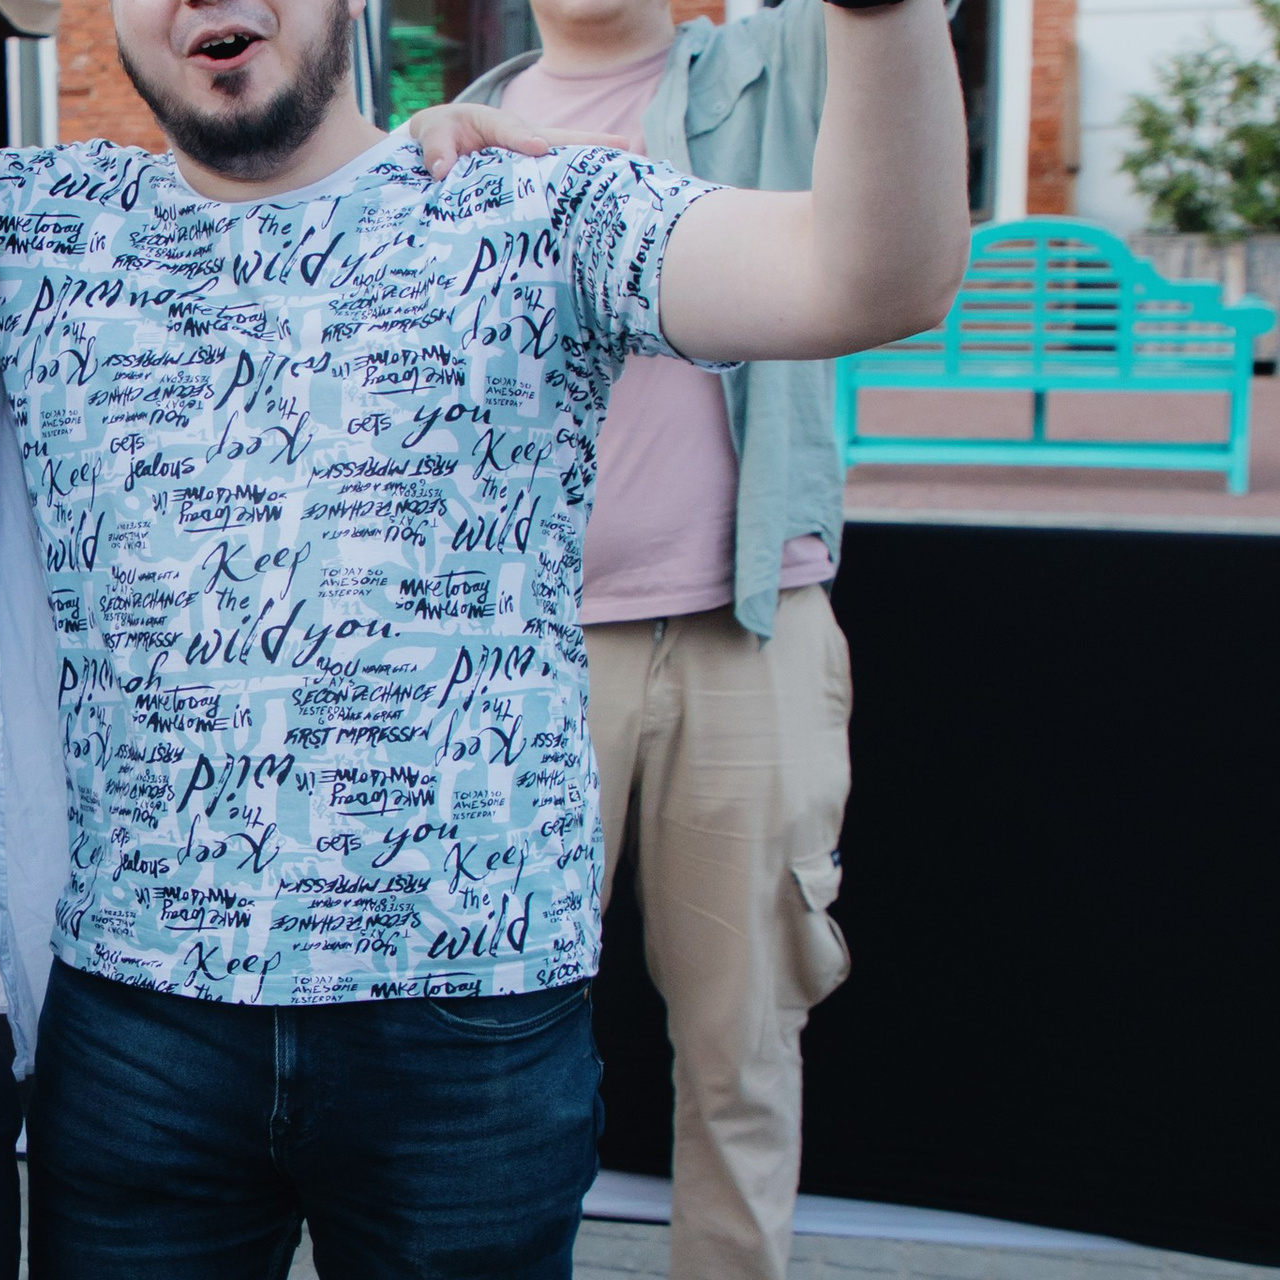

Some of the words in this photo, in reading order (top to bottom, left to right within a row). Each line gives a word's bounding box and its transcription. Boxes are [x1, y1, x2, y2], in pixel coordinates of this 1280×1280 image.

[20, 440, 51, 461] ou
[201, 541, 311, 602] Keep
[182, 941, 281, 1005] Keep
